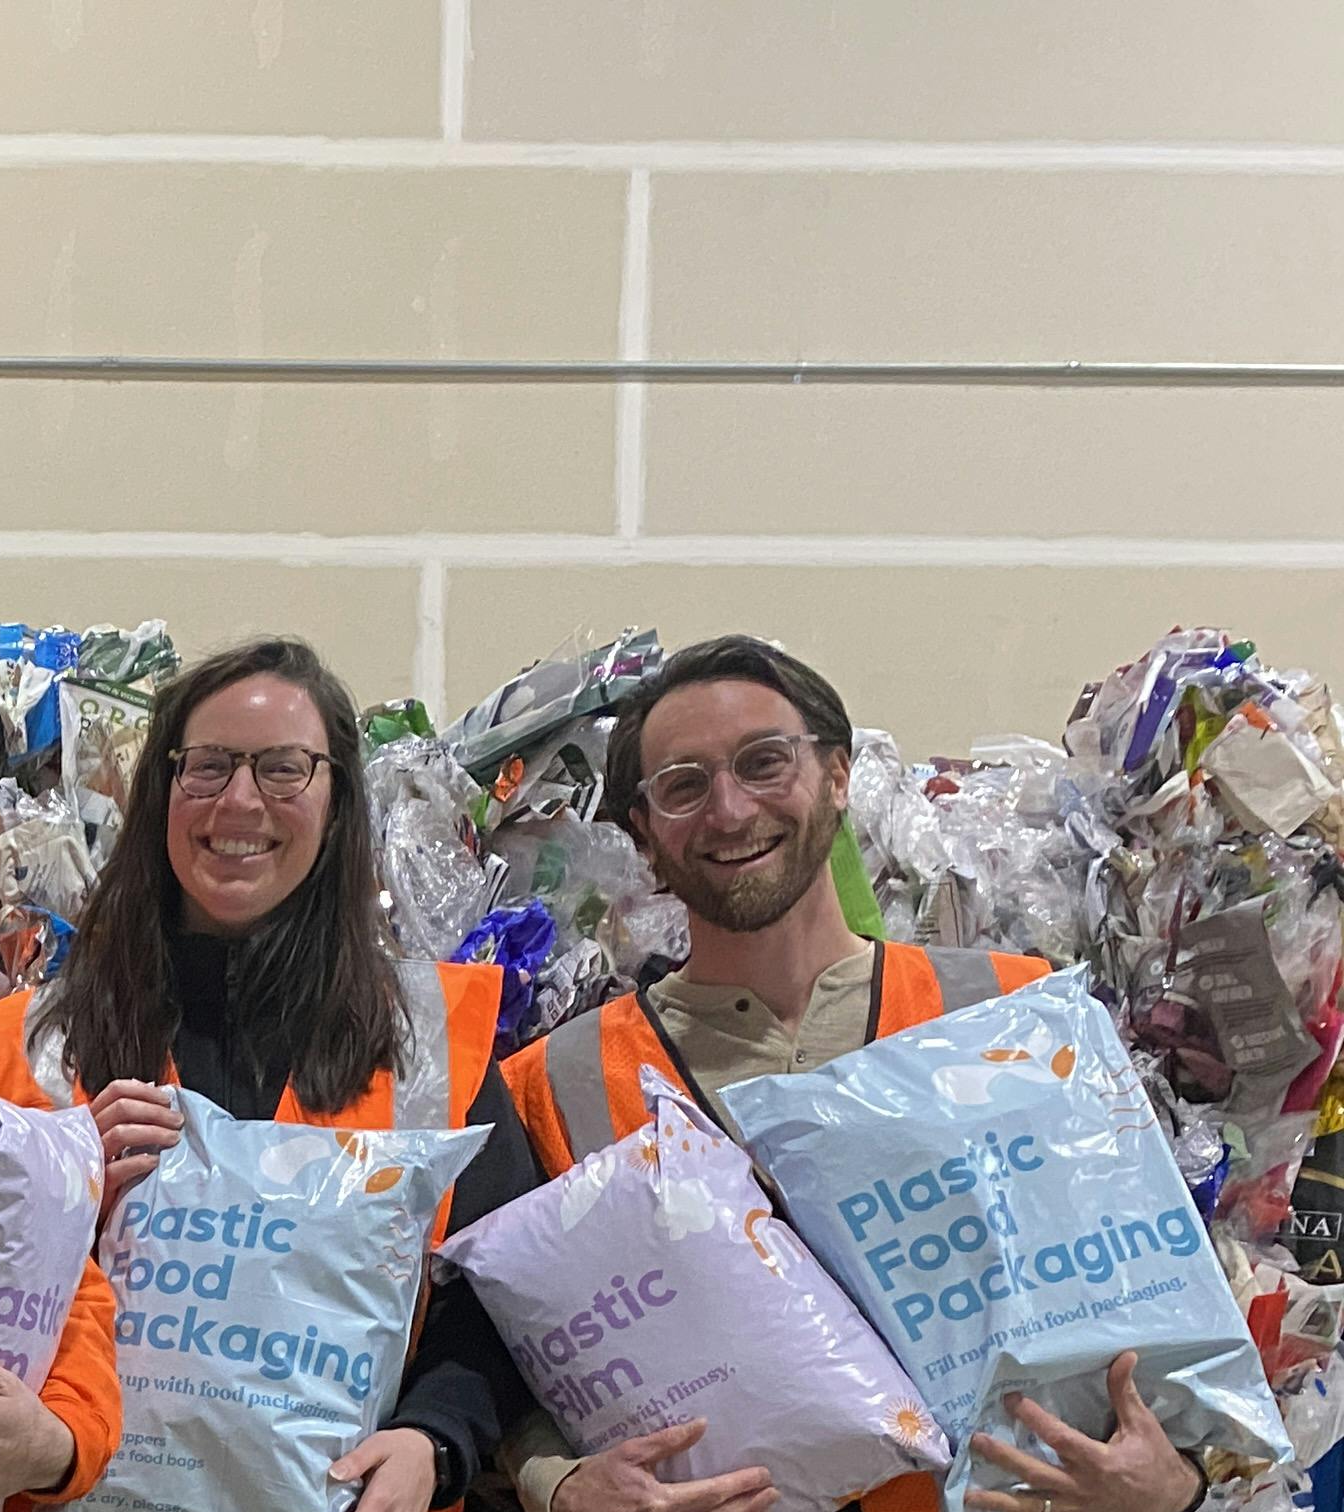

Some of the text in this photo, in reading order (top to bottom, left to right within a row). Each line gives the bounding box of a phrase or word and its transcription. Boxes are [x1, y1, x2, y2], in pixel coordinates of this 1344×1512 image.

[117, 1201, 298, 1254] Plastic
[865, 1190, 1018, 1292] Food
[108, 1253, 236, 1301] Food
[891, 1206, 1201, 1343] Packaging
[114, 1305, 374, 1400] ackaging
[513, 1269, 677, 1384] Plastic
[925, 1356, 957, 1382] Fill
[986, 1327, 1009, 1352] up
[1007, 1315, 1043, 1341] with
[1044, 1299, 1089, 1332] food
[1092, 1277, 1188, 1318] packaging.
[126, 1375, 340, 1424] up with food packaging.
[544, 1358, 643, 1421] Film
[610, 1421, 628, 1440] up
[627, 1395, 668, 1426] with
[666, 1363, 736, 1405] flimsy,
[129, 1449, 163, 1465] food
[166, 1453, 204, 1471] bags
